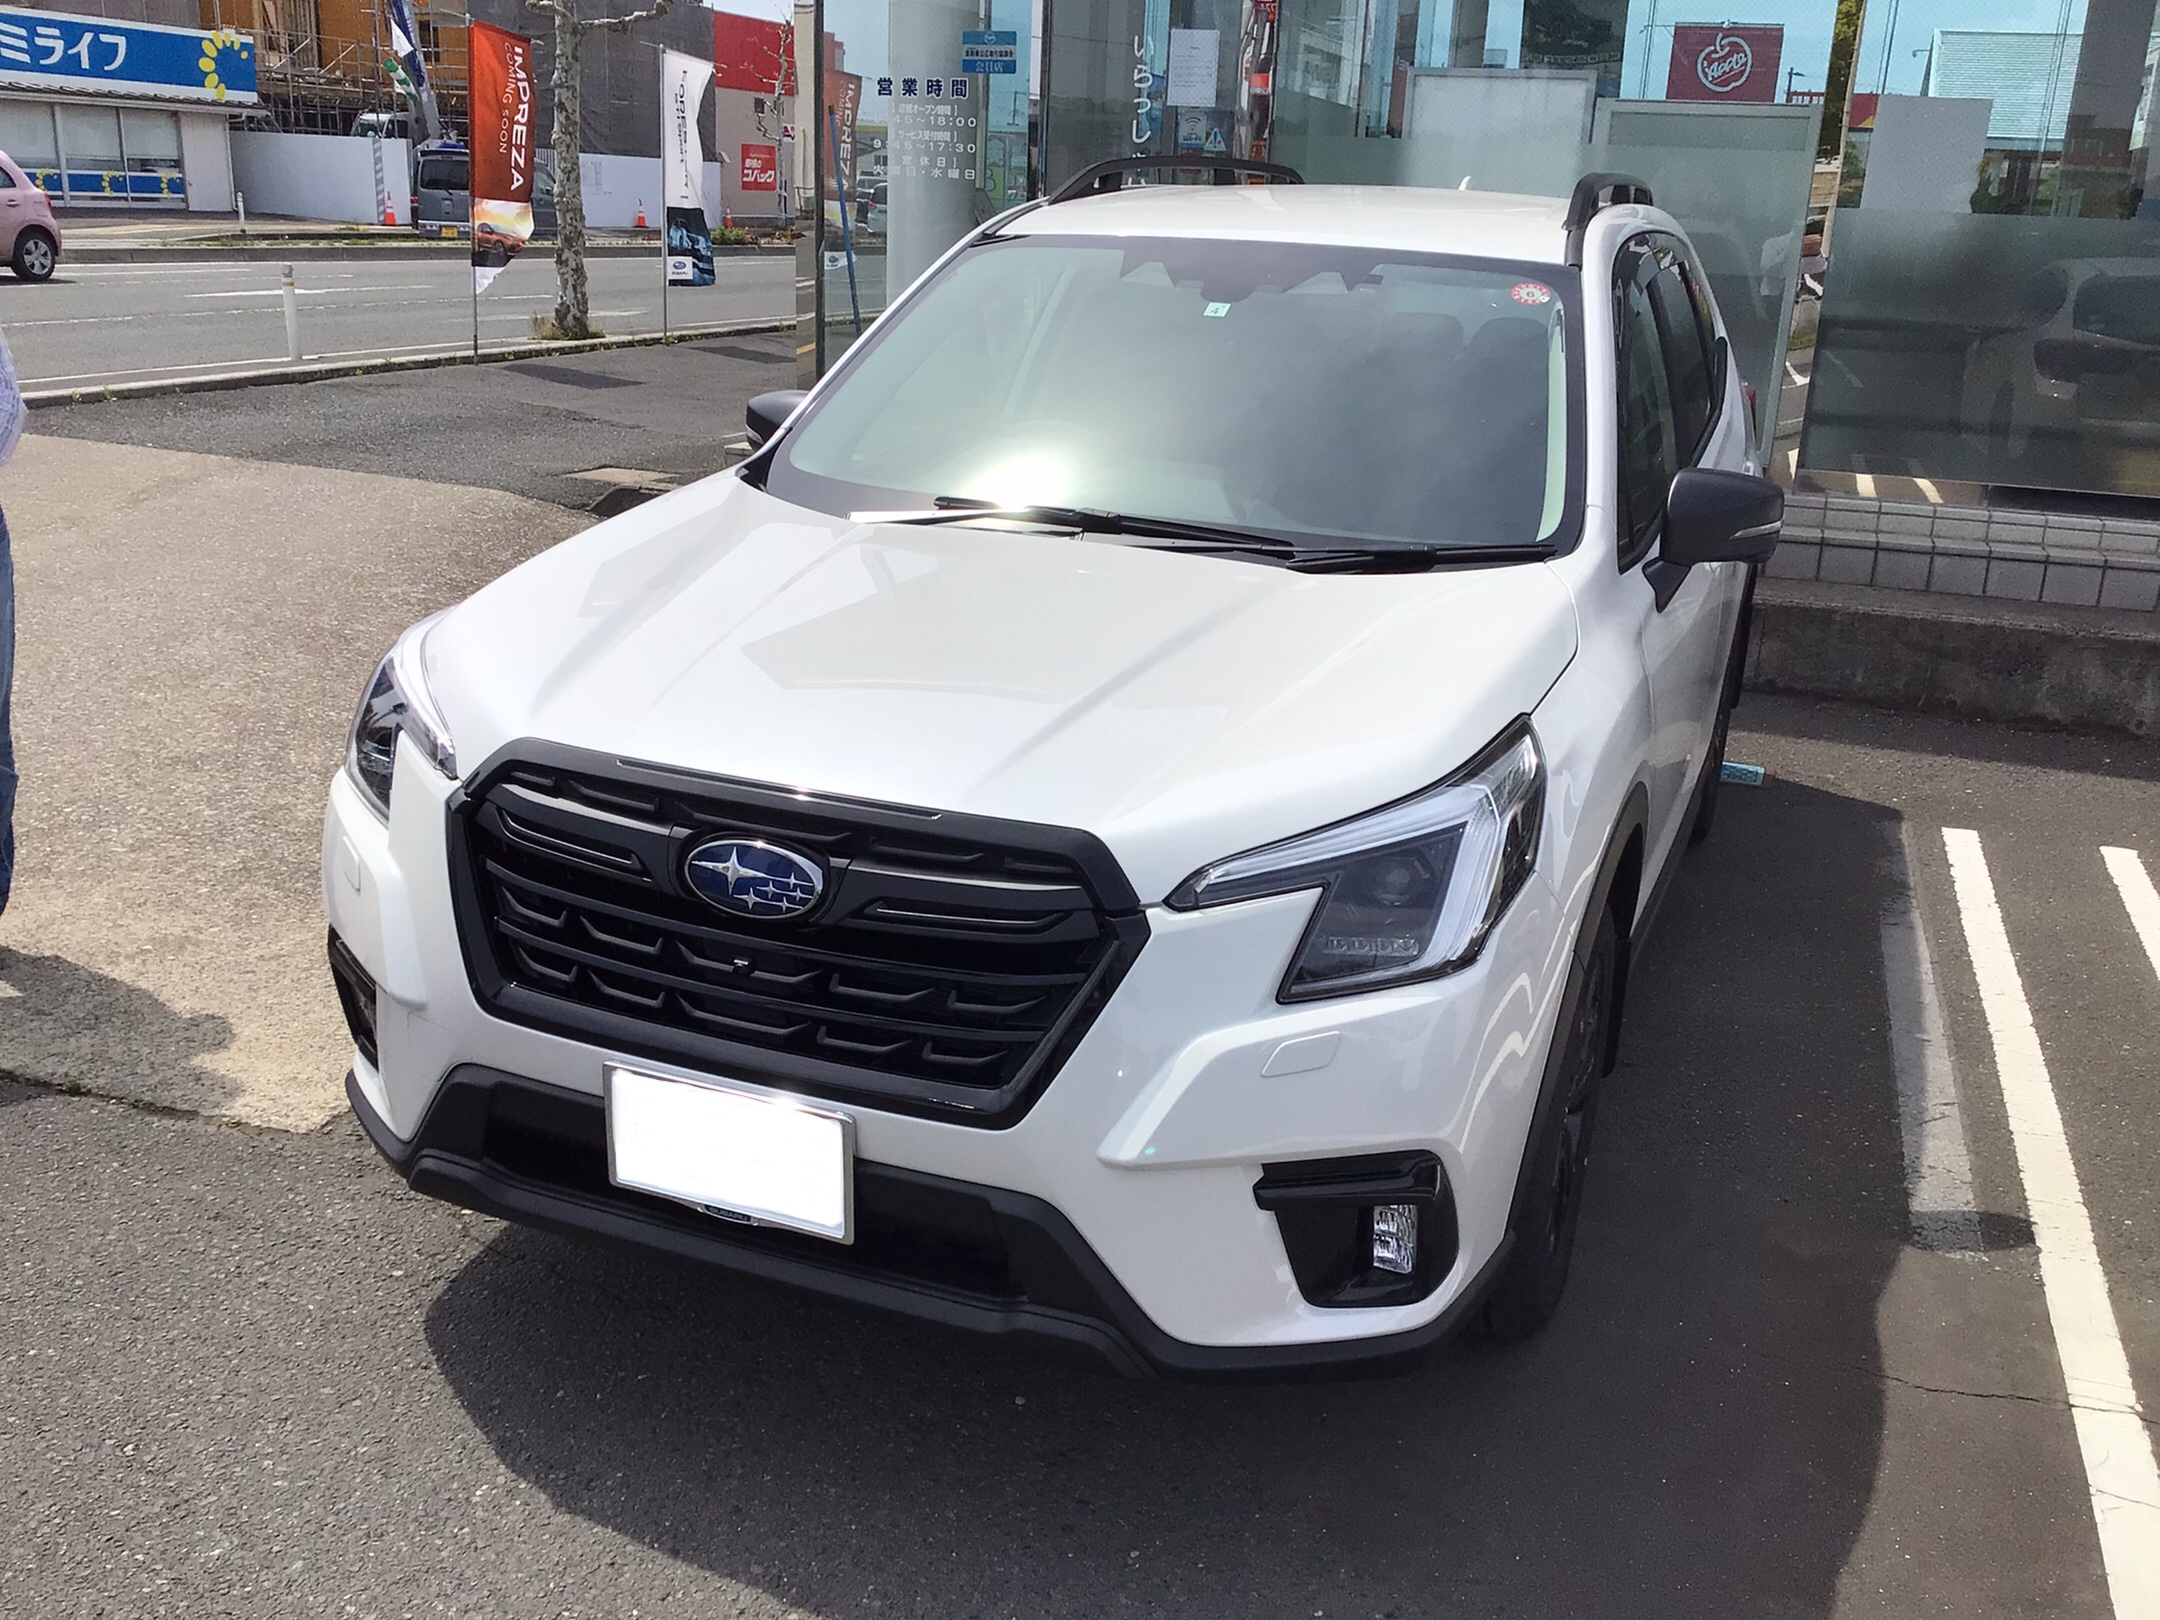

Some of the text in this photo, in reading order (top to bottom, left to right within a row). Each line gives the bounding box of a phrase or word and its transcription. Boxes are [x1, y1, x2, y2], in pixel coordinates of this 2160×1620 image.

[0, 22, 127, 71] ミライフ
[1705, 53, 1747, 80] Apple
[499, 42, 516, 153] COMING SOON
[877, 77, 969, 99] 営業時間
[510, 46, 530, 191] IMPREZA
[742, 169, 775, 183] コバック
[709, 1206, 748, 1221] SUBARU
